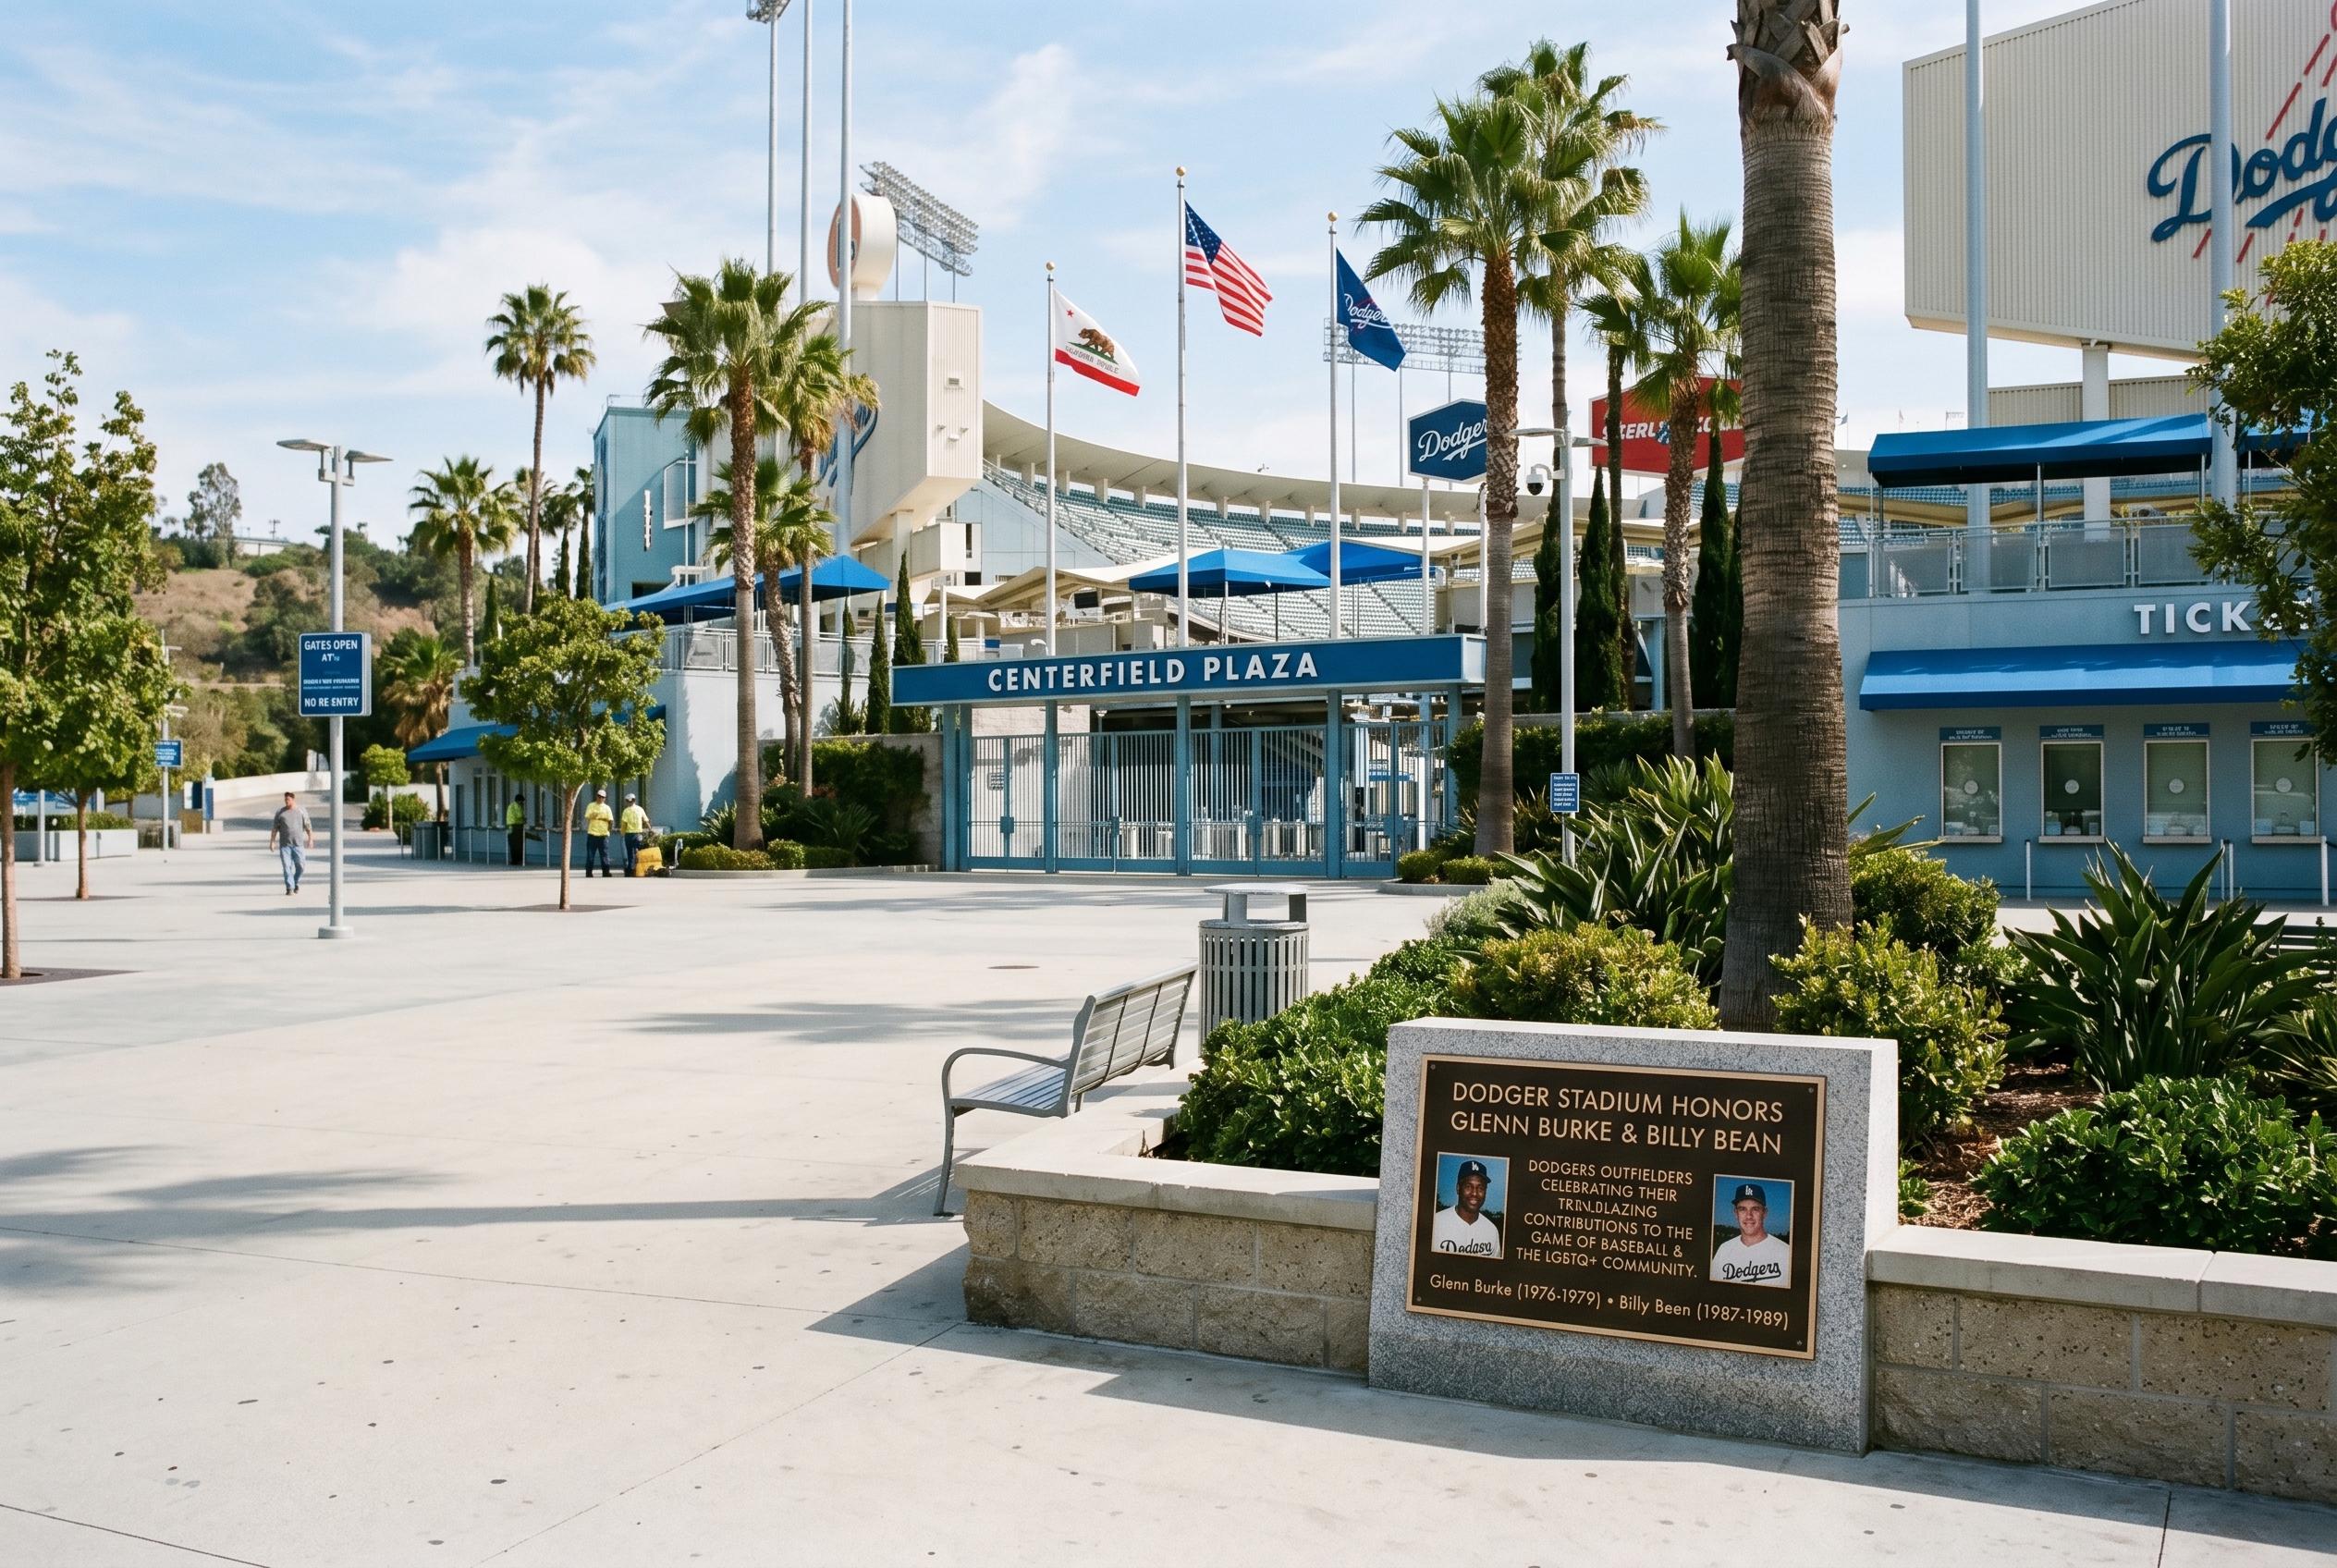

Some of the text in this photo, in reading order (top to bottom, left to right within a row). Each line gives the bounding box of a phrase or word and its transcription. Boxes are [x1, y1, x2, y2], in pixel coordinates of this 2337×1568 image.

[1418, 418, 1487, 462] Dodger
[2134, 600, 2311, 635] TICK
[304, 639, 358, 651] GATES OPEN
[987, 652, 1318, 692] CENTERFIELD PLAZA
[304, 697, 316, 707] NO
[1452, 1082, 1783, 1123] DODGER STADIUM HONORS
[1450, 1110, 1781, 1156] GLENN BURKE & BILLY BEAN
[1528, 1159, 1694, 1185] DODGERS OUTFIELDERS
[1541, 1178, 1678, 1203] CELEBRATING THEIR
[1523, 1212, 1694, 1241] CONTRIBUTIONS TO THE
[1531, 1231, 1683, 1258] GAME OF BASEBALL &
[1516, 1247, 1541, 1262] THE
[1602, 1256, 1698, 1279] COMMUNITY.
[1429, 1273, 1790, 1332] Glenn Burke (1976-1979) Billy Been (1987-1989)
